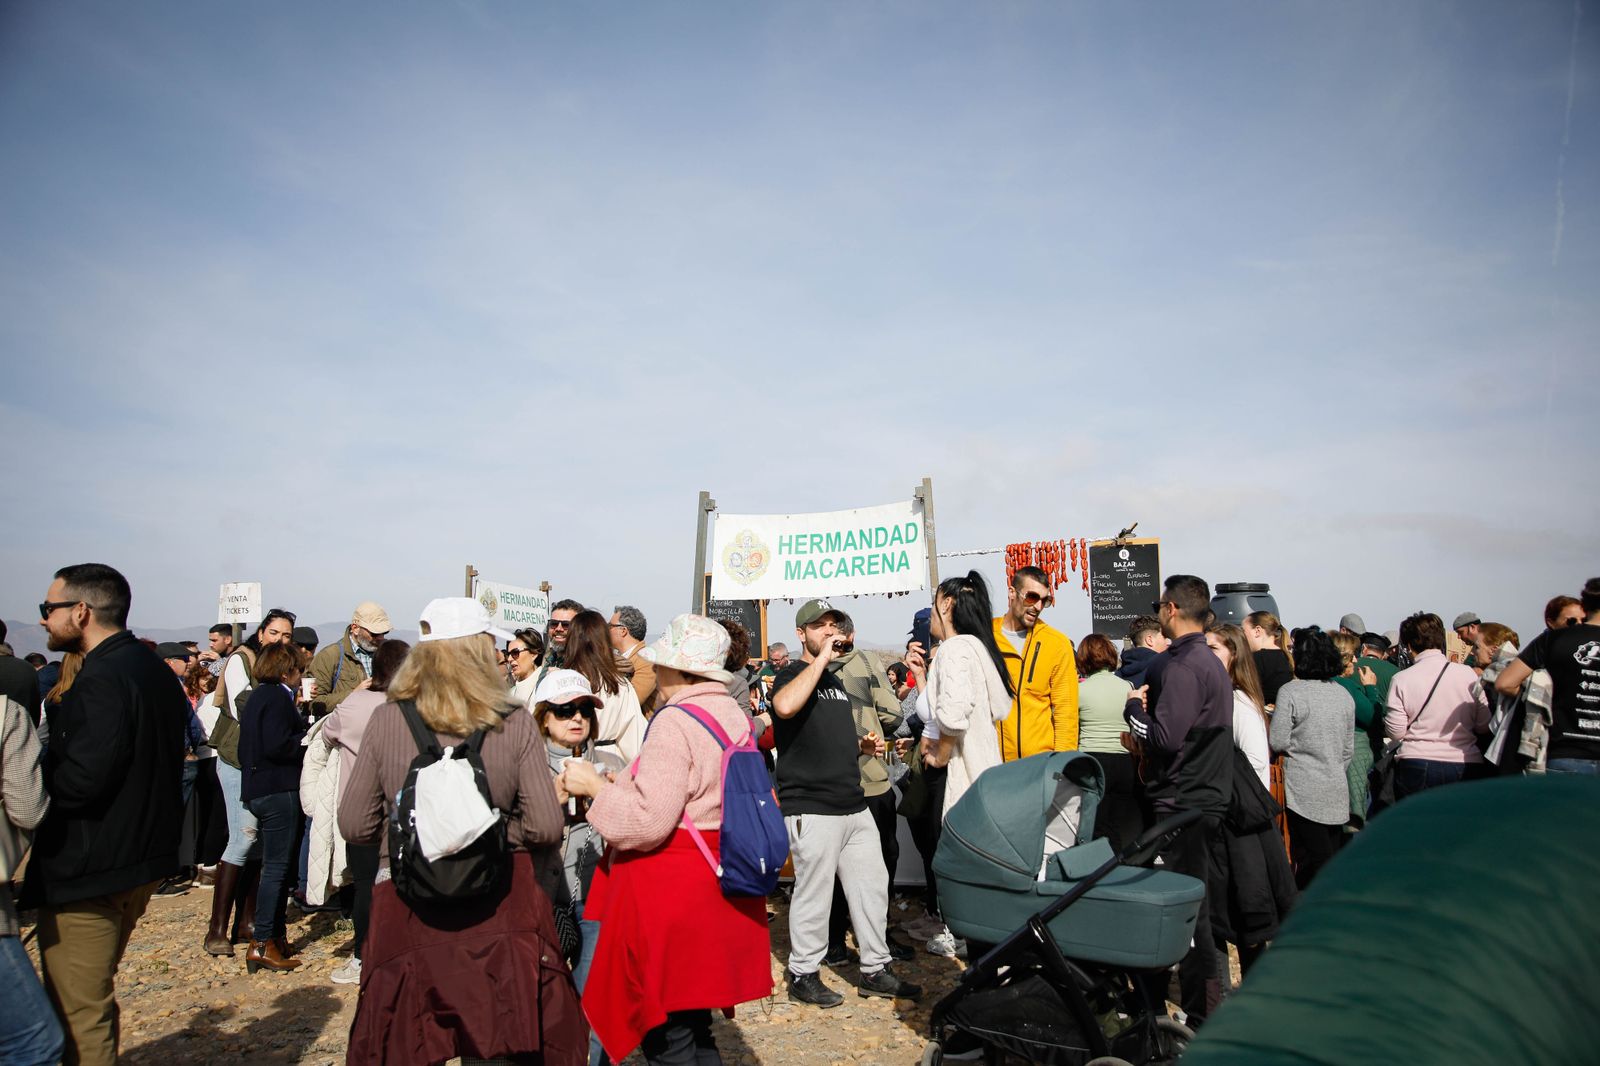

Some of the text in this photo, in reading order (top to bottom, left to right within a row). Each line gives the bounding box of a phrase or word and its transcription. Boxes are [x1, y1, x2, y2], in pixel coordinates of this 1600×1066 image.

[778, 522, 918, 555] HERMANDAD
[784, 550, 910, 580] MACARENA
[500, 592, 547, 609] HERMANDAD
[226, 607, 249, 615] TICKETS
[504, 609, 547, 625] MACARENA
